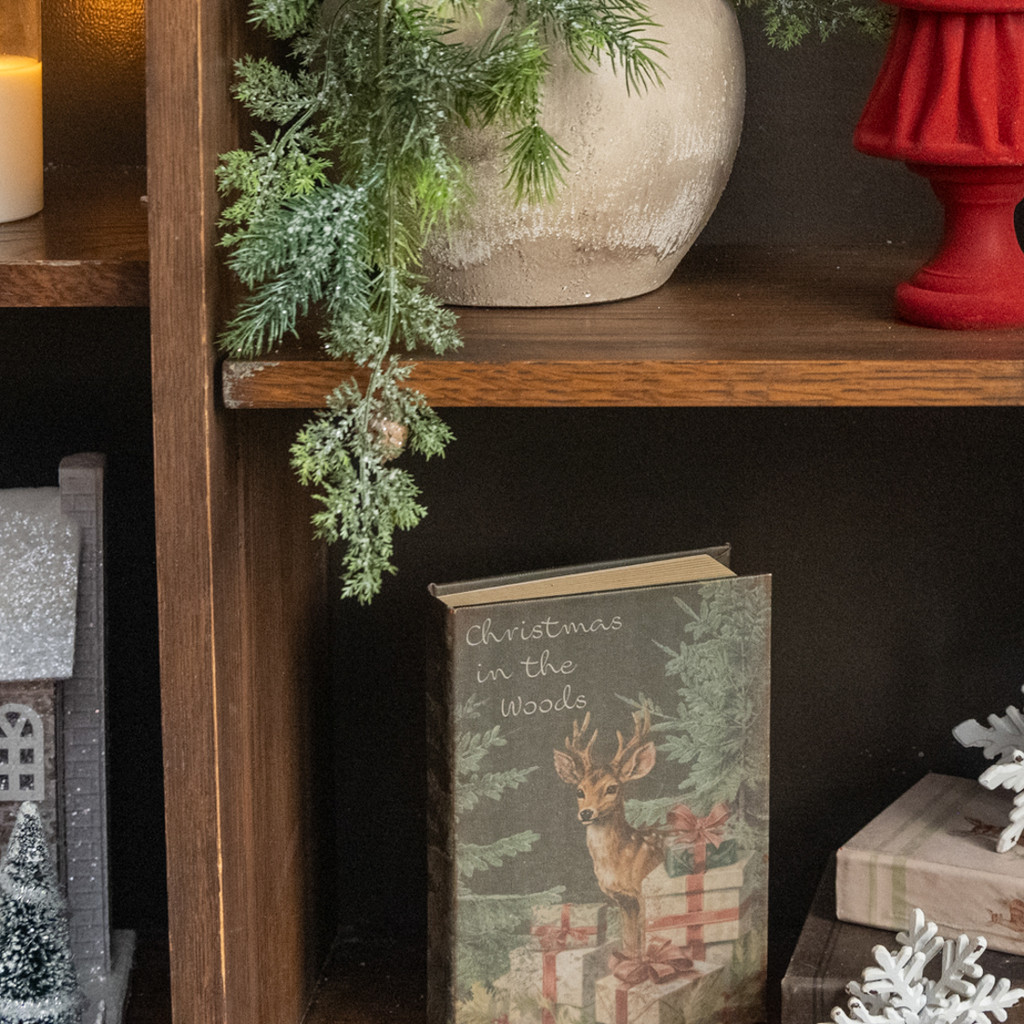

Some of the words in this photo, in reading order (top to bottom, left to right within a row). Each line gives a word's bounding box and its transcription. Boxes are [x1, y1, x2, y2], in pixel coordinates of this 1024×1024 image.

[465, 616, 623, 646] Christmas
[476, 663, 514, 684] in
[520, 649, 578, 678] the
[501, 684, 587, 718] Woods
